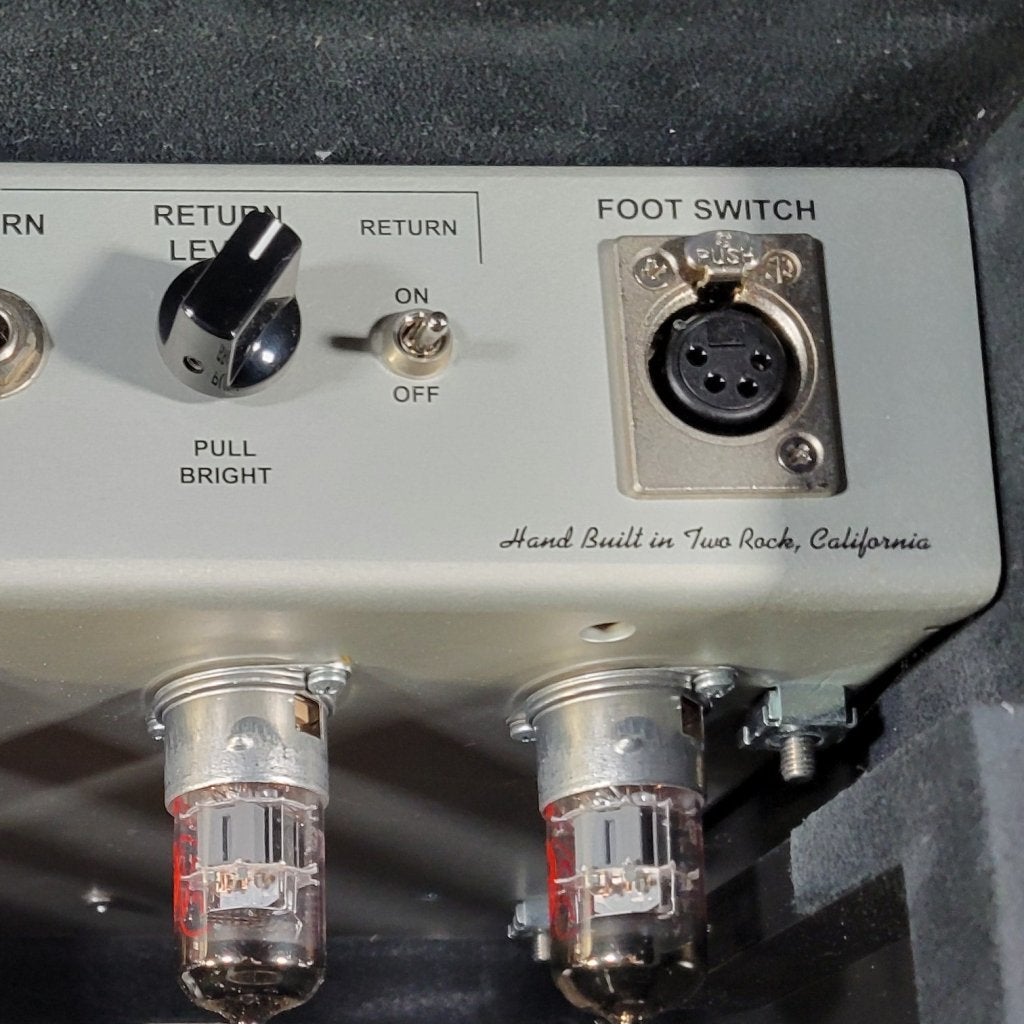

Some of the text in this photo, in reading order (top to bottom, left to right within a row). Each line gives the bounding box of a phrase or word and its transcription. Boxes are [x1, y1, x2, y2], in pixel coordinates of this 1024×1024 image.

[597, 198, 816, 221] FOOT SWITCH
[360, 219, 457, 237] RETURN
[695, 246, 756, 265] PUSH
[394, 287, 429, 305] ON
[392, 385, 440, 403] OFF
[193, 439, 257, 457] PULL
[180, 466, 273, 485] BRIGHT
[498, 525, 932, 560] Hand Built in Two Rock, California
